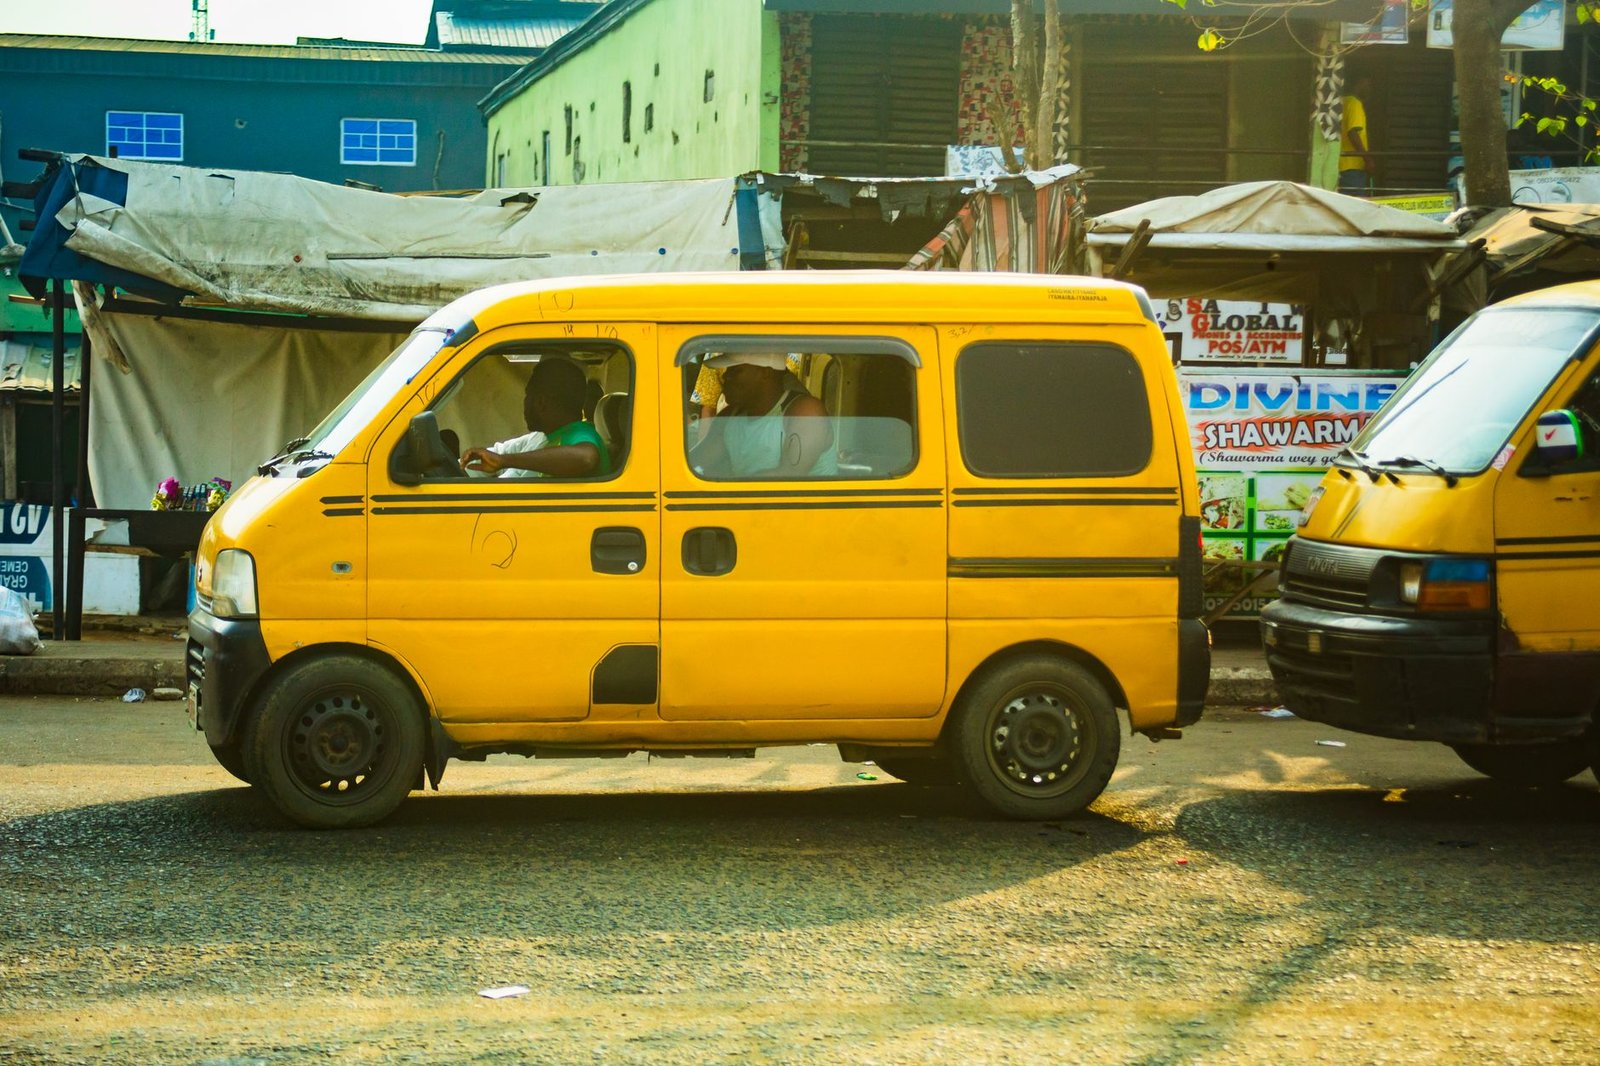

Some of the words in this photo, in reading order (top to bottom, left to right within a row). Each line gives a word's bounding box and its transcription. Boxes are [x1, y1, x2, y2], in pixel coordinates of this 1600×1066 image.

[1191, 314, 1297, 331] GLOBAL
[1208, 340, 1287, 354] POS/ATM
[1189, 383, 1397, 410] DIVINE
[1289, 455, 1316, 465] wey
[1321, 455, 1337, 466] ge
[0, 561, 28, 573] CEME
